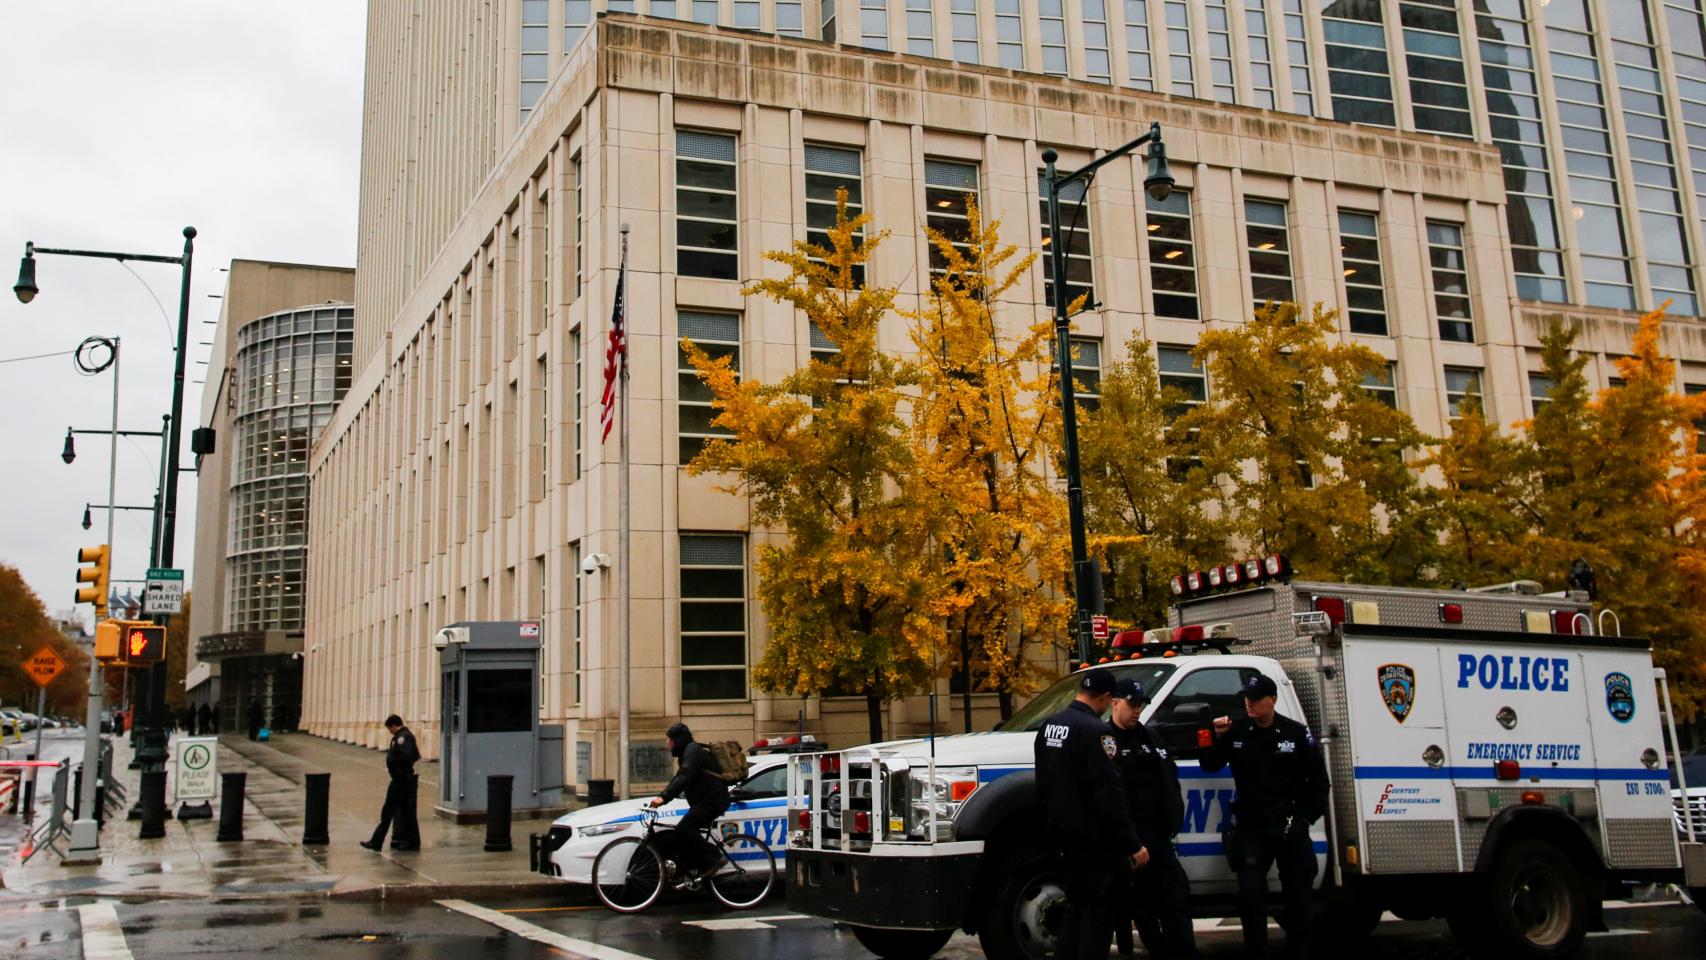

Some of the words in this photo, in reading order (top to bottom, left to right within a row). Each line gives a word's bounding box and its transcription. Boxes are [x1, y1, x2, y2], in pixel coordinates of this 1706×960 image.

[146, 593, 181, 601] SHARED
[151, 602, 174, 610] LANE
[33, 657, 56, 665] RAISE
[1385, 666, 1405, 674] POLICE
[1457, 653, 1569, 692] POLICE
[1606, 674, 1630, 686] POLICE
[1044, 724, 1070, 739] NYPD
[1467, 743, 1533, 760] EMERGENCY
[1535, 744, 1581, 760] SERVICE
[1384, 784, 1421, 794] COURTESY
[1625, 782, 1639, 795] ESU
[1379, 794, 1441, 804] PROFESSIONALISM
[1374, 804, 1407, 815] RESPECT
